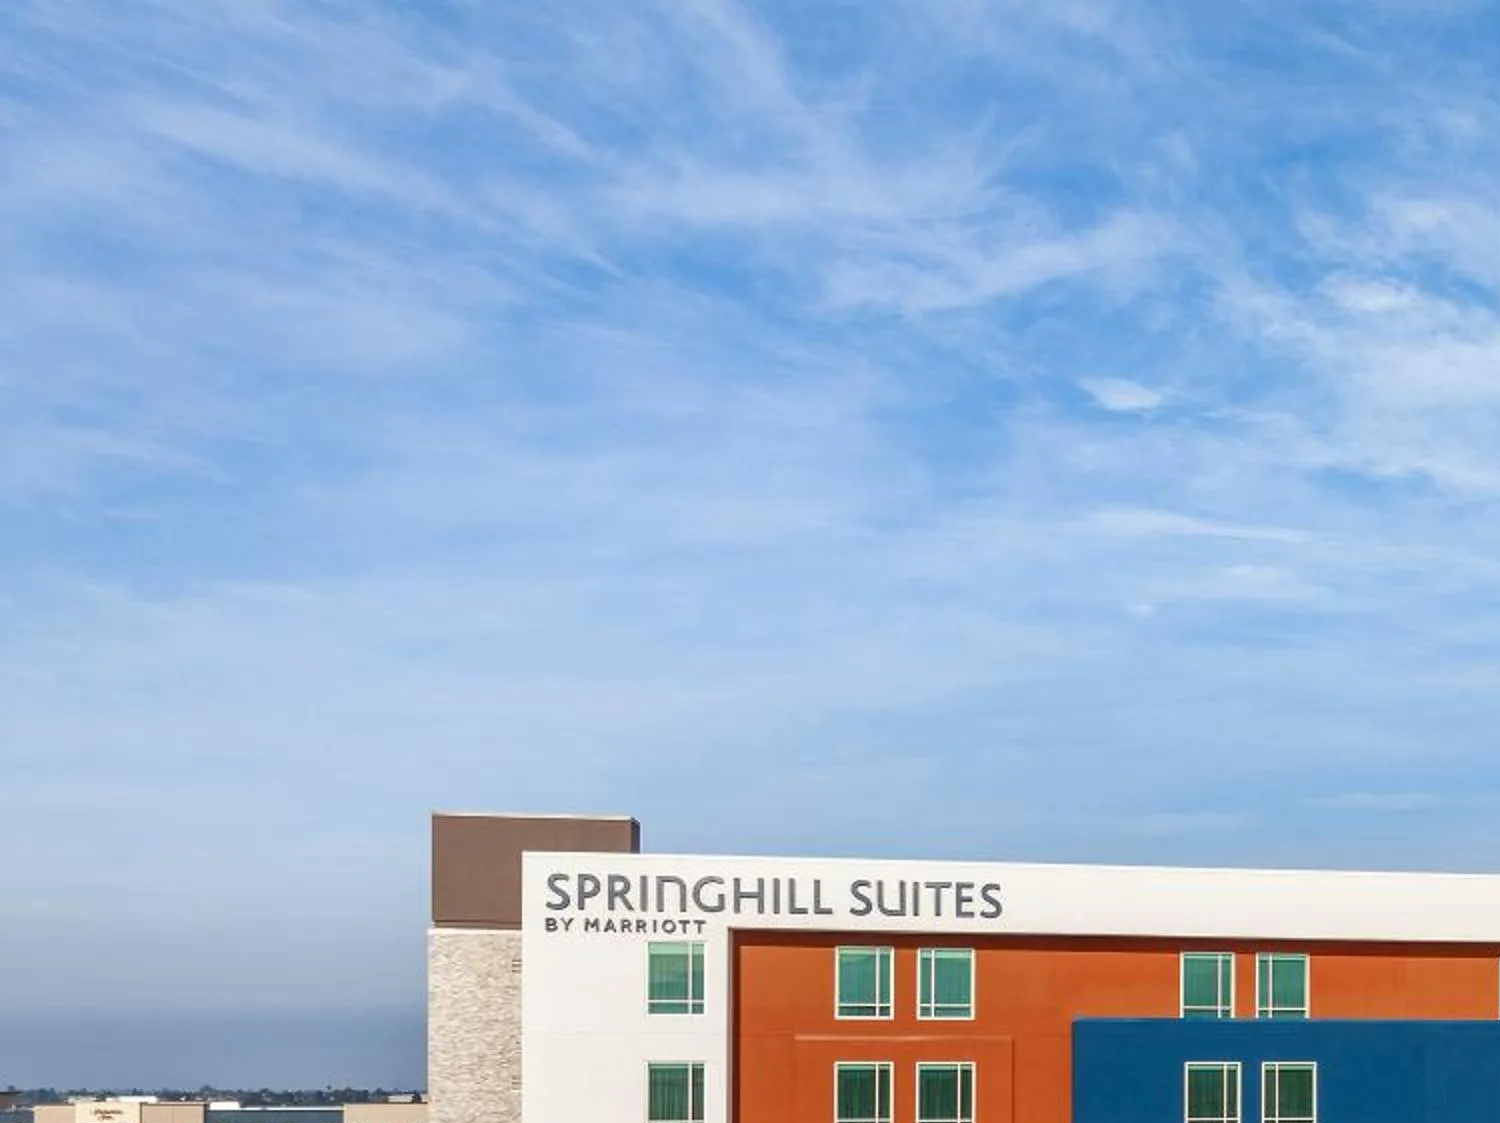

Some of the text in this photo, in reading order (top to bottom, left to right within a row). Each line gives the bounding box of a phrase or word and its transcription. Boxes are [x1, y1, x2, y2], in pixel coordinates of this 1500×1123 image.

[546, 873, 1003, 919] SPRINGHILL SUITES
[545, 917, 707, 935] BY MARRIOTT
